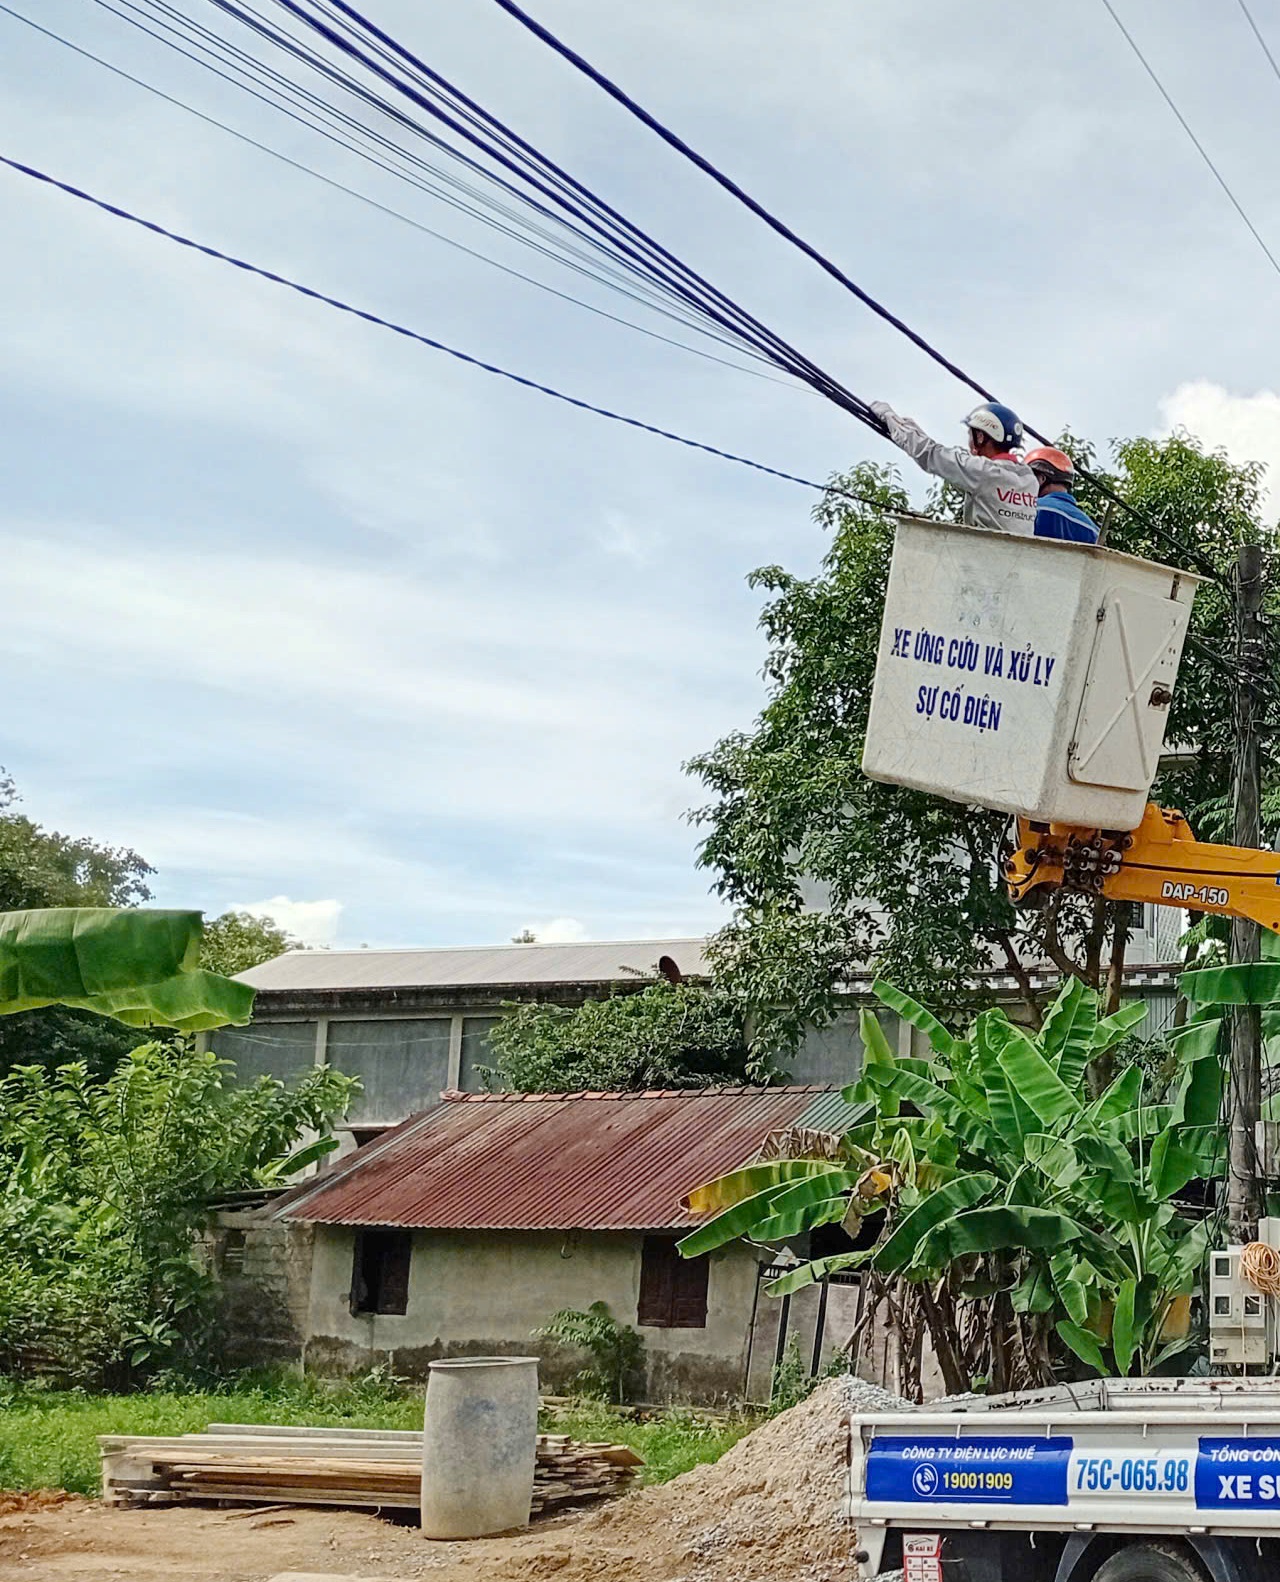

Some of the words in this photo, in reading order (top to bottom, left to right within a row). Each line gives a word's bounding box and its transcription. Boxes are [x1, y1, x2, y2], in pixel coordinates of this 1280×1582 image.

[890, 628, 912, 658] XE
[914, 627, 945, 665] ỨNG
[947, 635, 979, 672] CỨU
[984, 642, 1004, 677] VÀ
[1007, 643, 1034, 682] XỬ
[916, 685, 940, 721] SỰ
[940, 684, 965, 722] CỐ
[963, 693, 1002, 733] ĐIỆN
[1161, 880, 1229, 906] DAP-150
[902, 1446, 935, 1459] CÔNG
[938, 1447, 953, 1459] TY
[953, 1446, 982, 1461] ĐIỆN
[983, 1446, 1007, 1462] LỰC
[1009, 1444, 1036, 1460] HUẾ
[1210, 1444, 1249, 1462] TỔNG
[943, 1472, 1012, 1489] 19001909
[1076, 1458, 1189, 1491] 75C-065.98
[1218, 1475, 1252, 1500] XE
